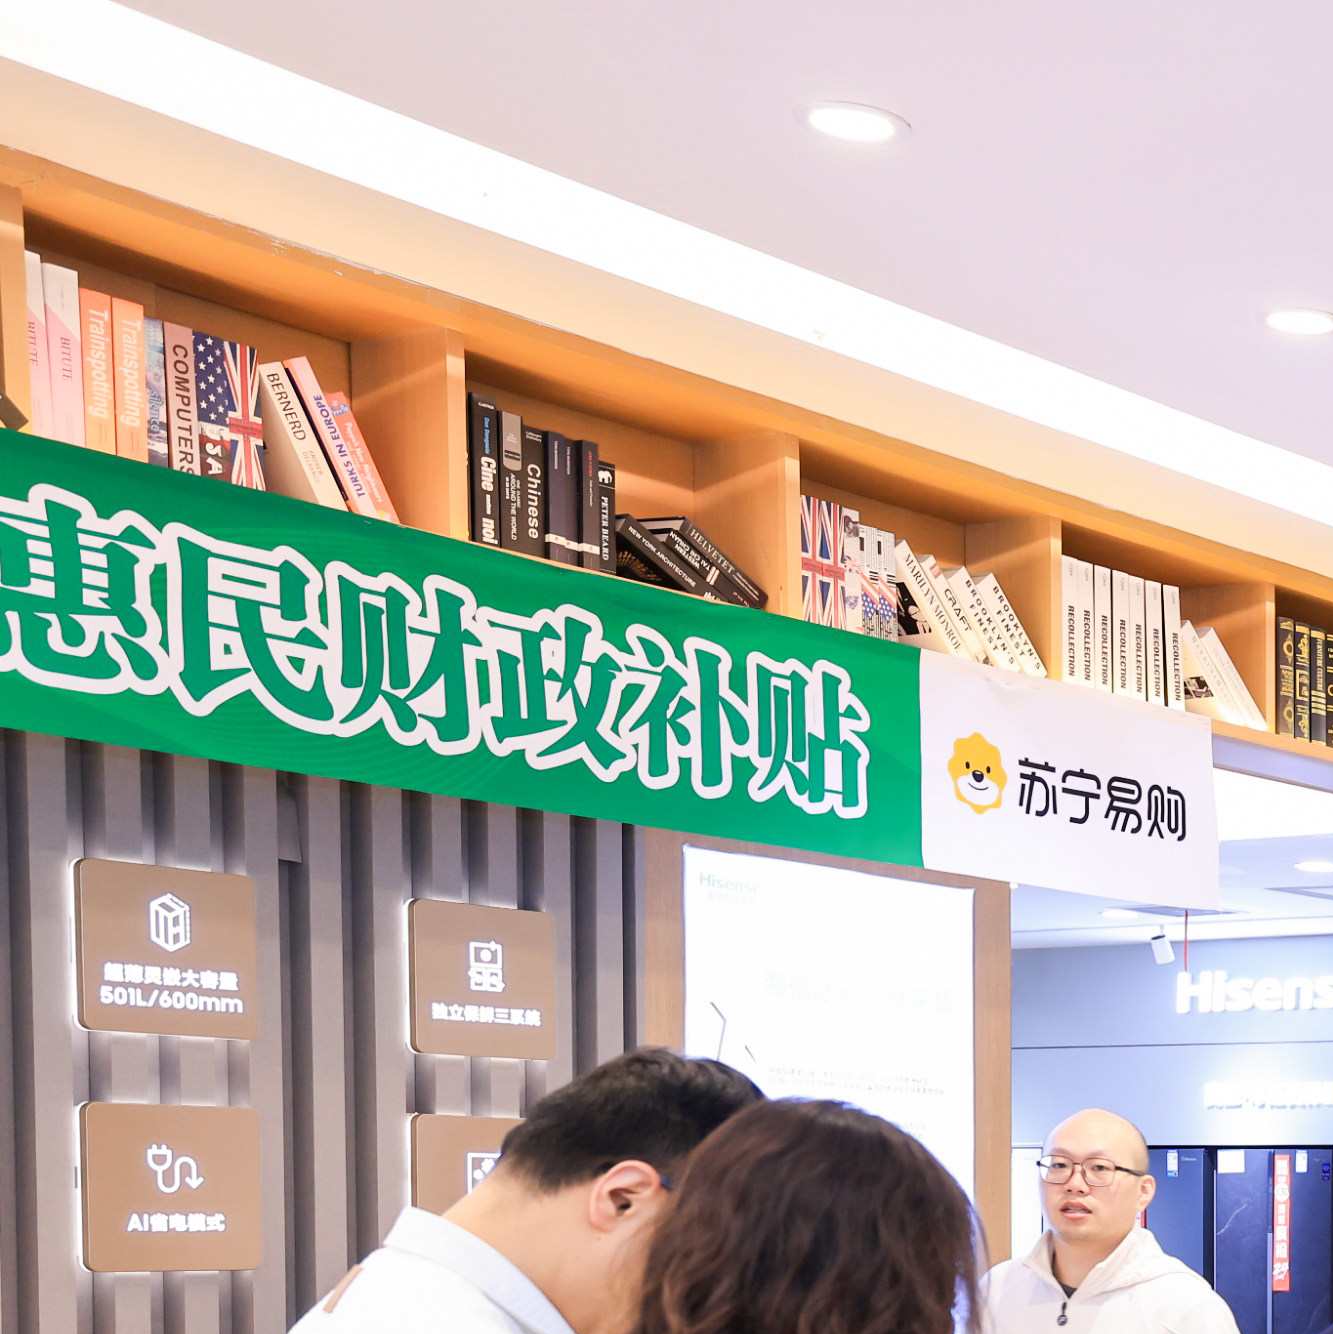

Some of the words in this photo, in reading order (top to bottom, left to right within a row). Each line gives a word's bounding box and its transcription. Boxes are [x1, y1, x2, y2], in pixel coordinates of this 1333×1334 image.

[86, 308, 109, 420] Trainspotting
[118, 318, 142, 428] Trainspotting
[267, 372, 307, 441] BERNERD
[313, 395, 340, 441] EUROPE
[336, 443, 349, 457] IN
[344, 461, 366, 498] TURKS
[480, 456, 497, 492] Cine
[510, 473, 518, 502] AROUND
[526, 463, 542, 540] Chinese
[600, 496, 610, 527] PETER
[481, 517, 499, 545] noi
[510, 516, 518, 541] WORLD
[600, 528, 610, 561] BEARD
[690, 528, 735, 575] HELVETET
[628, 526, 641, 540] NEW
[641, 537, 657, 553] YORK
[656, 551, 697, 588] ARCHITECTURE
[903, 552, 935, 607] MARILYN
[931, 605, 963, 653] MONROE
[943, 588, 973, 633] CRAFT
[965, 579, 1015, 665] BROOKLYN'S
[0, 484, 870, 818] 惠民财政补贴
[969, 604, 998, 652] FINEST
[992, 586, 1042, 670] BROOKLYN'S
[996, 610, 1025, 657] FINEST
[1119, 619, 1127, 690] RECOLLECTION
[1135, 623, 1143, 694] RECOLLECTION
[1153, 628, 1161, 697] RECOLLECTION
[1172, 632, 1182, 701] RECOLLECTION
[1017, 757, 1188, 842] 苏宁易购
[699, 872, 761, 895] Hisense
[99, 986, 244, 1013] 501L/600mm
[431, 1002, 541, 1027] 独立保鲜三系统
[126, 1213, 226, 1233] AI省电模式
